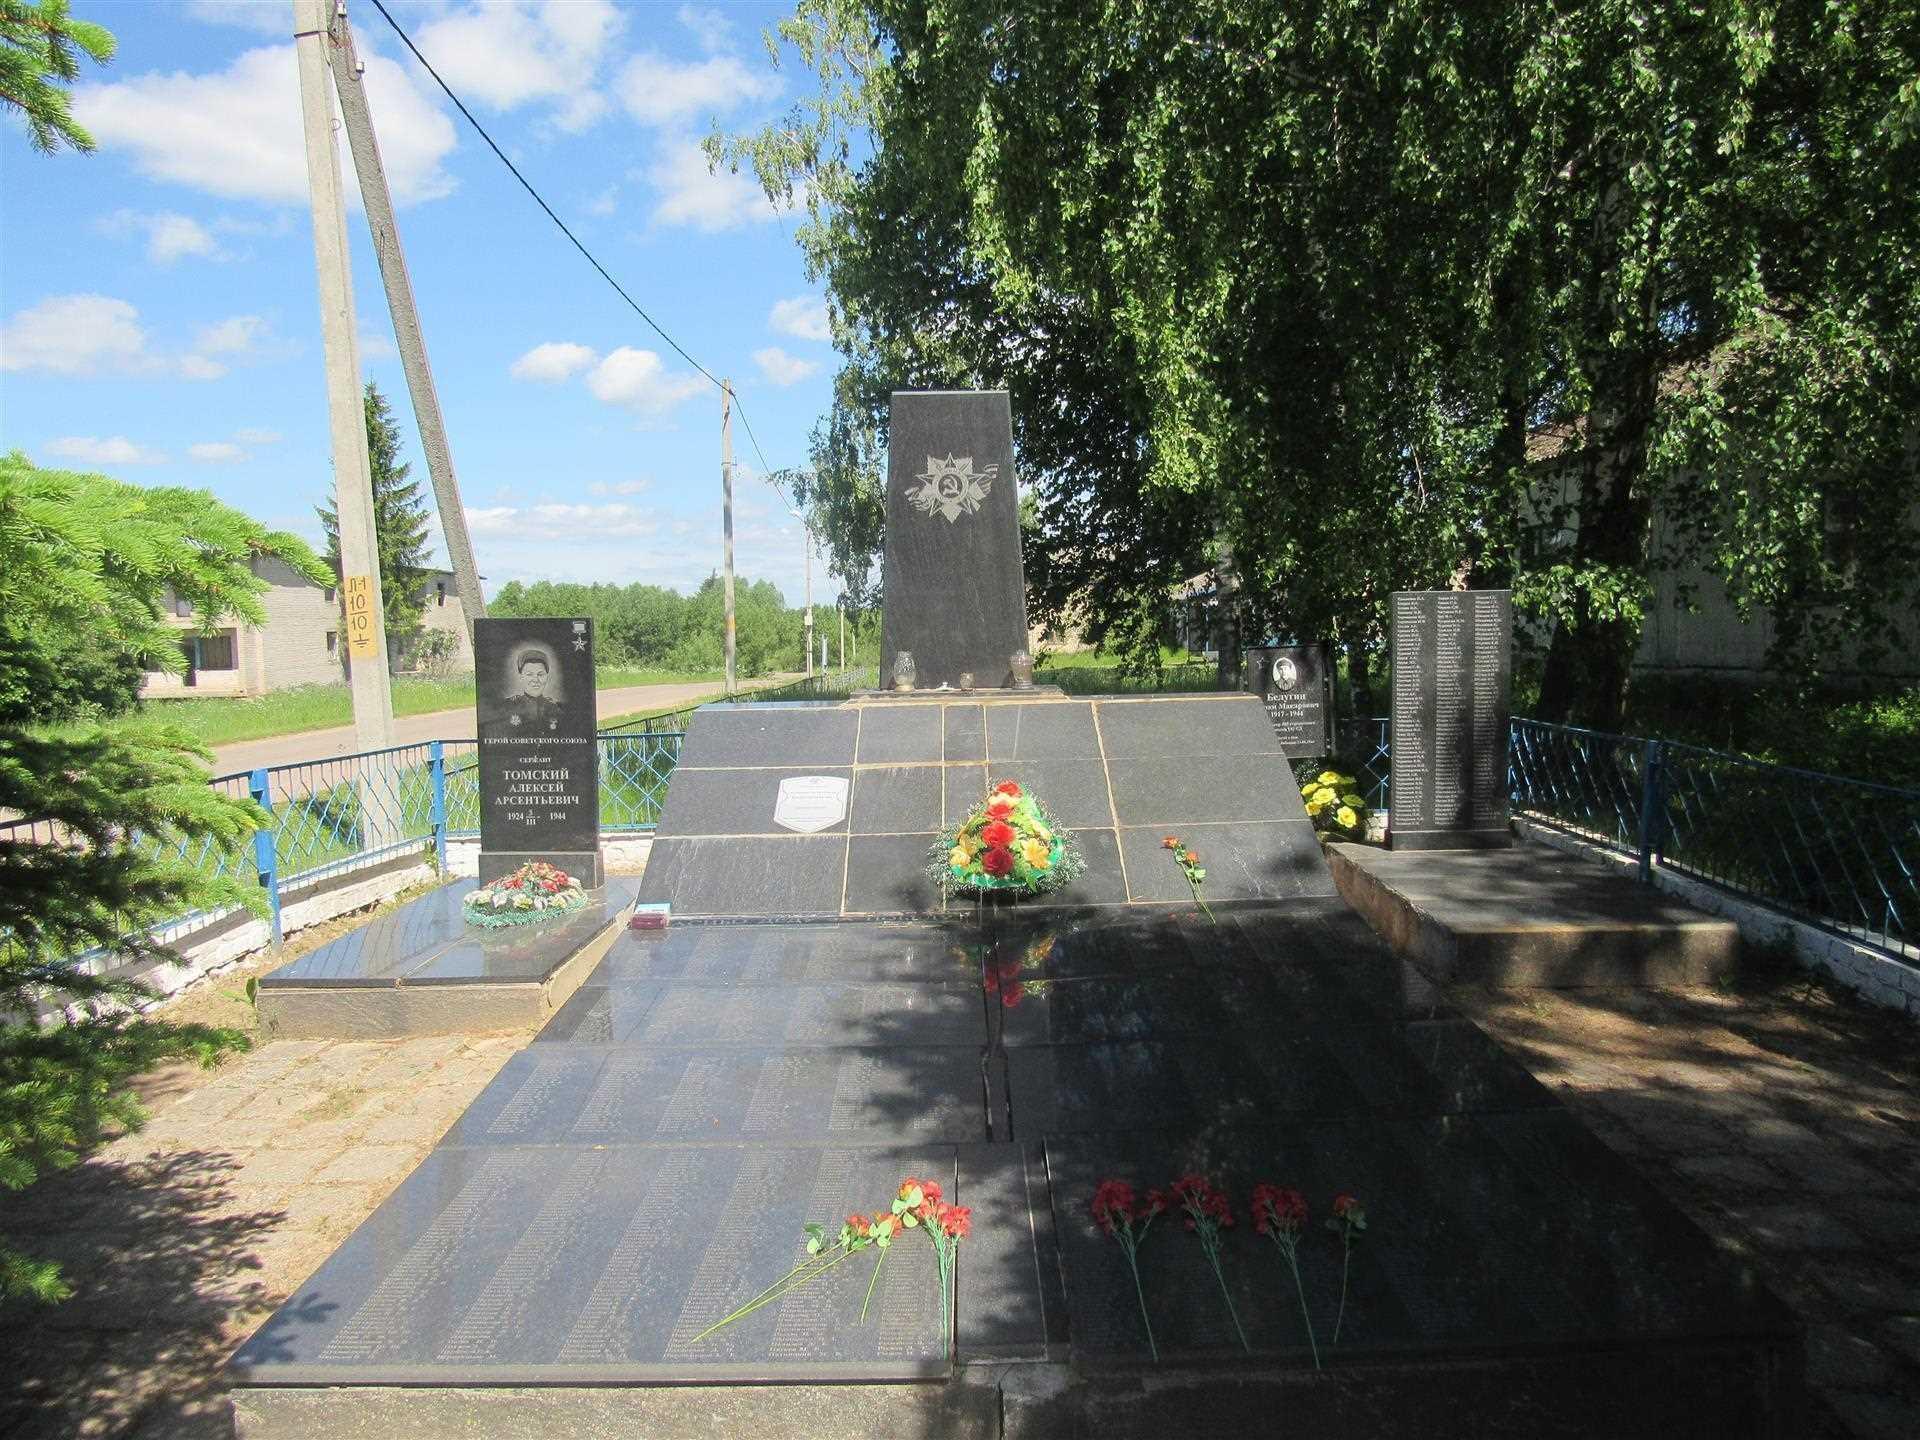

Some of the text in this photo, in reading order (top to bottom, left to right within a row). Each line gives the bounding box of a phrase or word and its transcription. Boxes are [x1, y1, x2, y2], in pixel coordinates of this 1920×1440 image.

[350, 594, 366, 610] 10
[351, 616, 367, 630] 10
[1267, 693, 1306, 703] Белугин
[484, 737, 509, 745] ГЕРОЙ
[503, 767, 569, 780] ТОМСКИЙ
[508, 781, 565, 793] АЛЕКСЕЙ
[495, 795, 580, 806] АРСЕНТЬЕВИЧ
[508, 812, 524, 820] 1924
